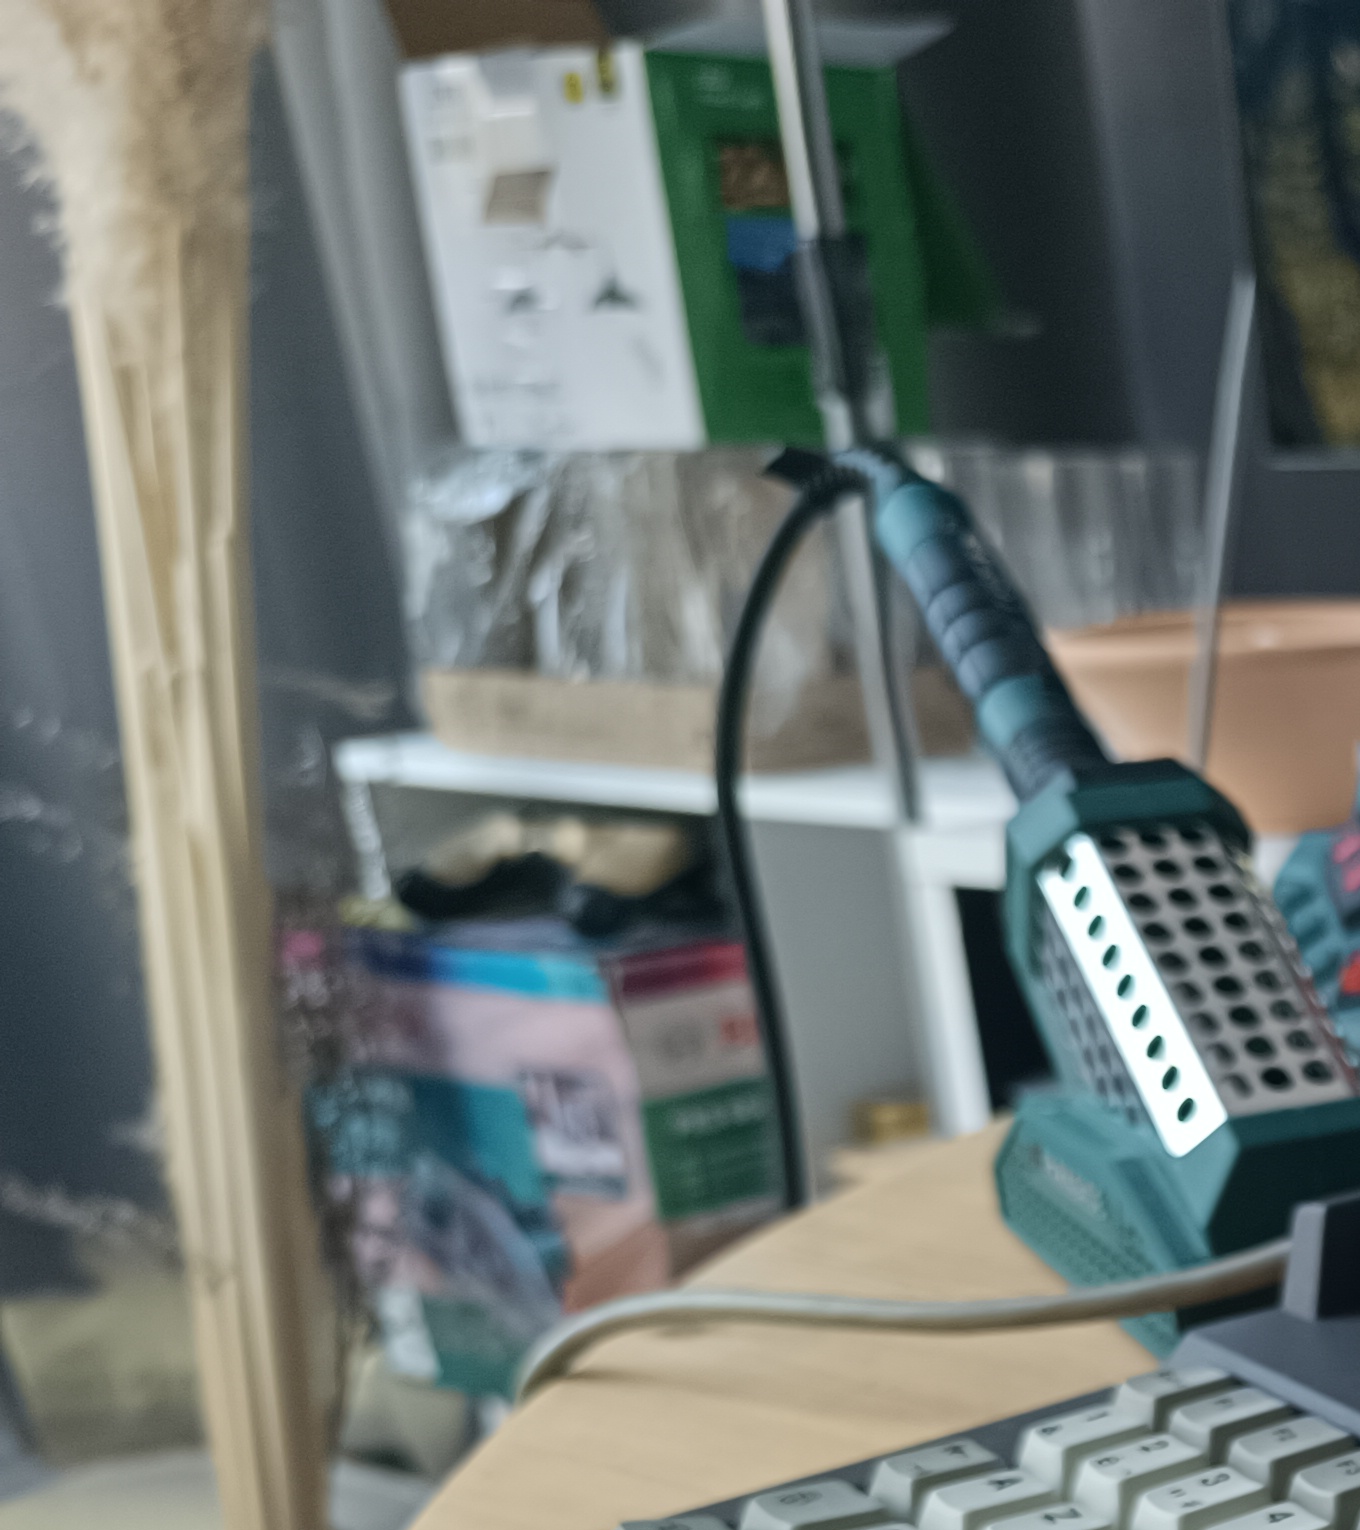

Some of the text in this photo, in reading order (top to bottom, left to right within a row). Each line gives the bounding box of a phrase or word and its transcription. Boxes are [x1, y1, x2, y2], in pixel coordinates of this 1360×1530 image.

[985, 1475, 1025, 1492] A
[1044, 1508, 1084, 1524] Z
[1267, 1511, 1296, 1525] 4
